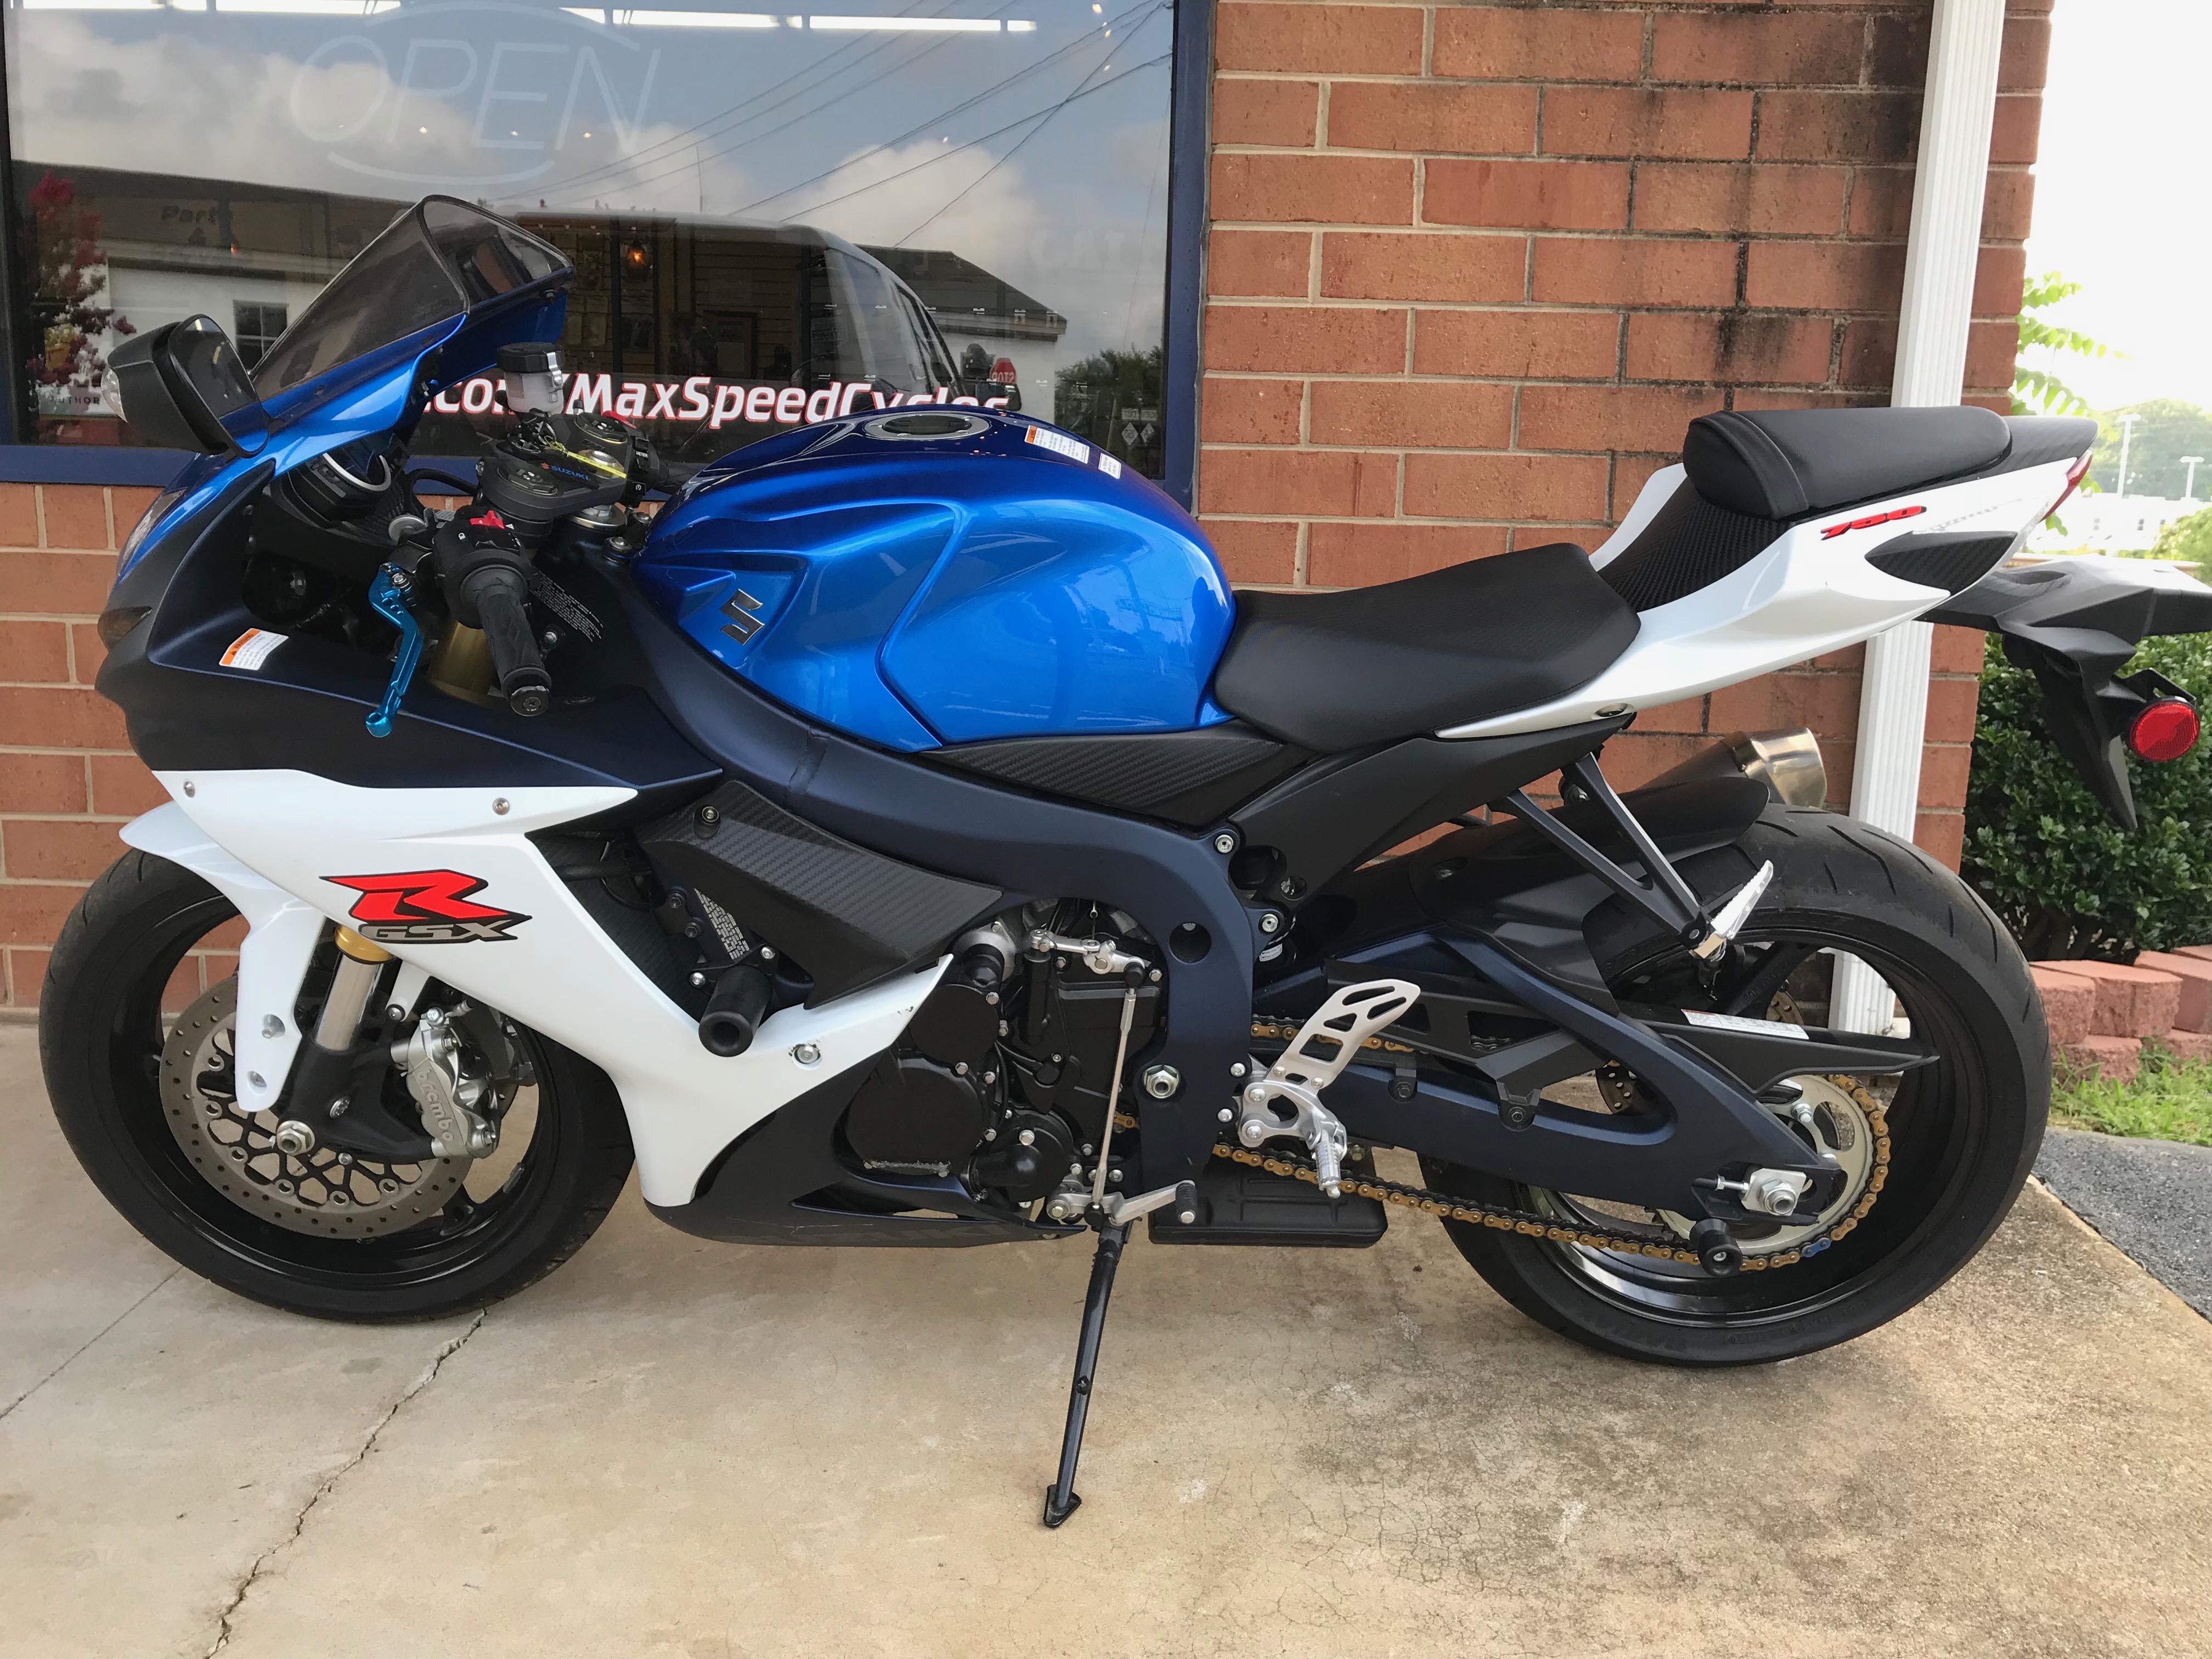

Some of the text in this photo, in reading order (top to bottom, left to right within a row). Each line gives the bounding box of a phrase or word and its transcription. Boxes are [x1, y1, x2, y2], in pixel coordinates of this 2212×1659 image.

[290, 35, 662, 154] OPEN
[551, 465, 589, 481] SUZUKI
[1820, 505, 1927, 540] 750
[358, 920, 518, 944] GSX
[416, 1067, 455, 1142] brembo
